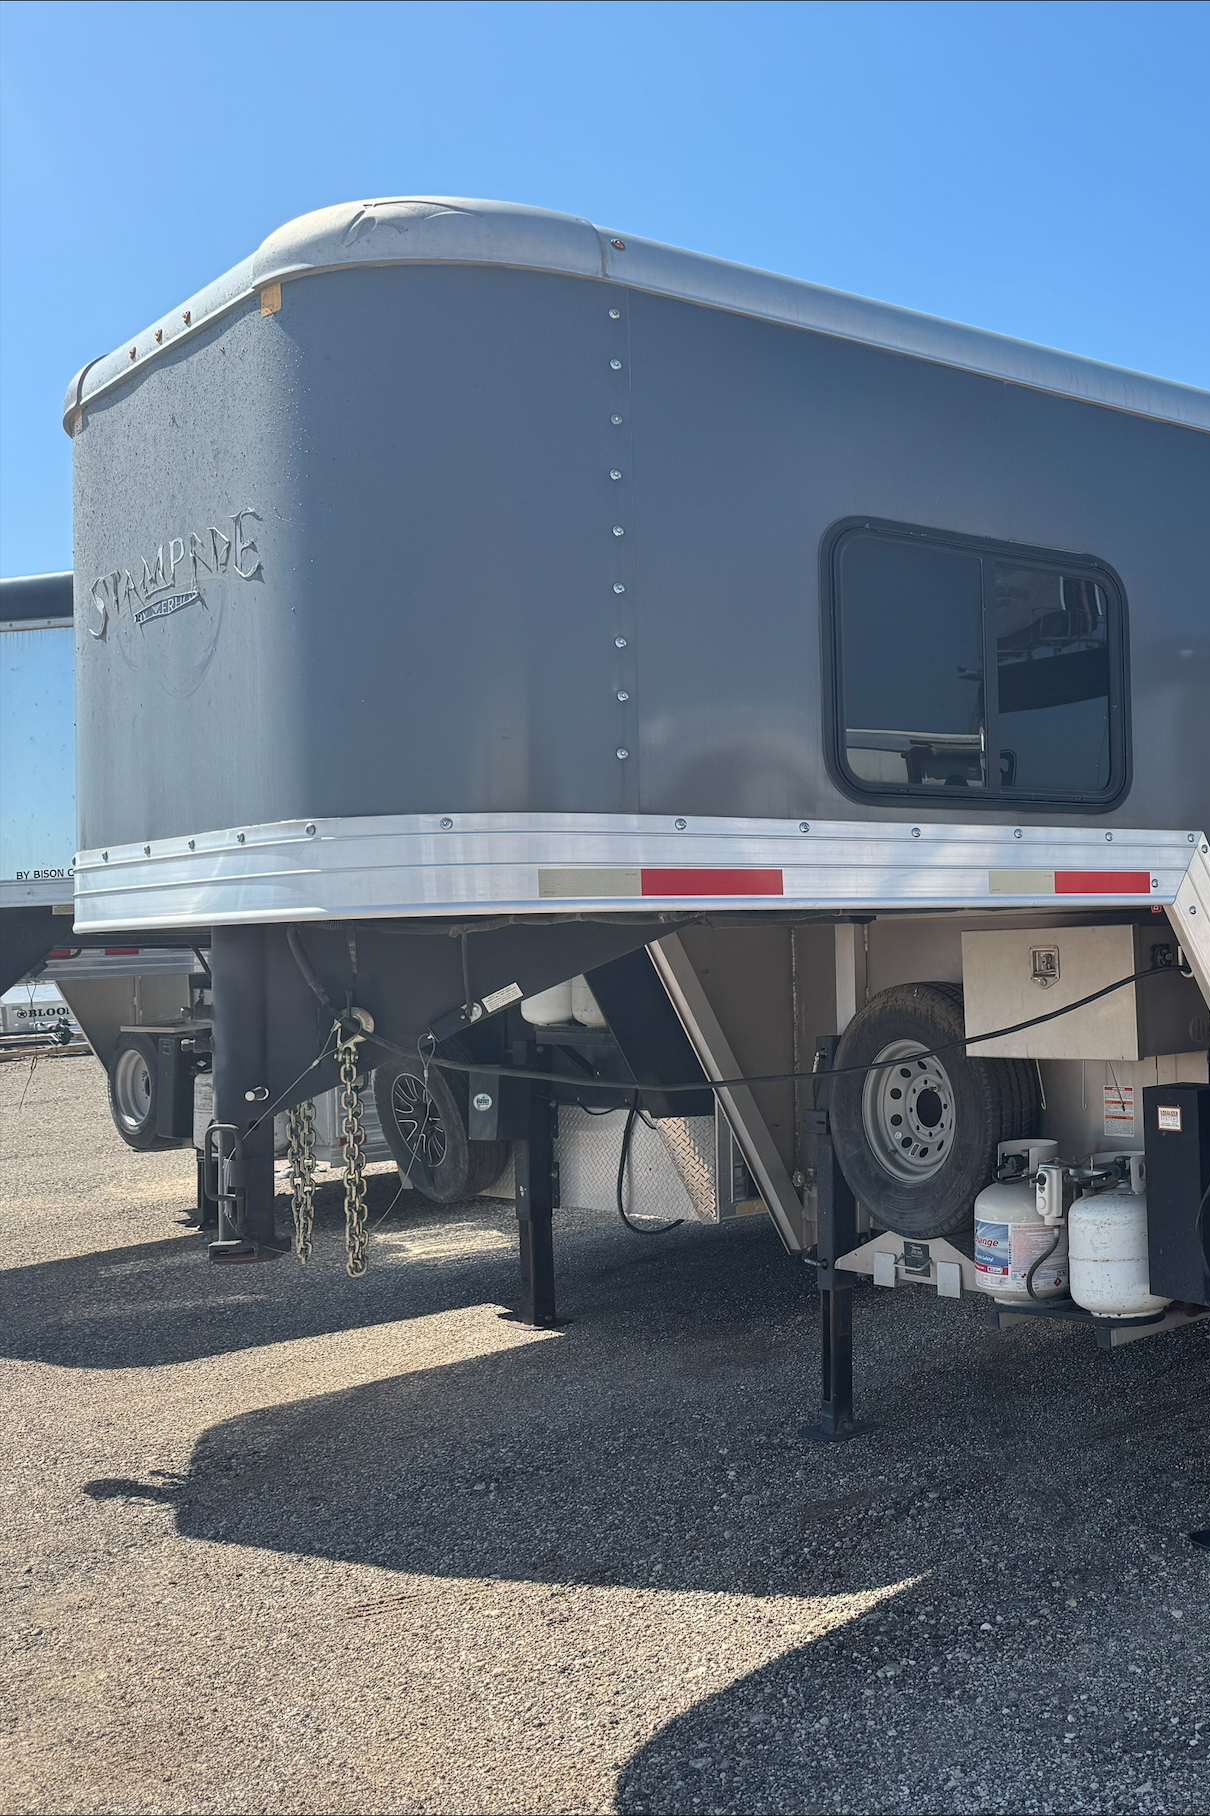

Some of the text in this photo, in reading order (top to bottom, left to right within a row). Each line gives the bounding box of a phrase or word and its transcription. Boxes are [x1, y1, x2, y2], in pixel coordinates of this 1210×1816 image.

[152, 592, 196, 615] MERH
[16, 871, 30, 880] BY
[34, 869, 64, 879] BISON
